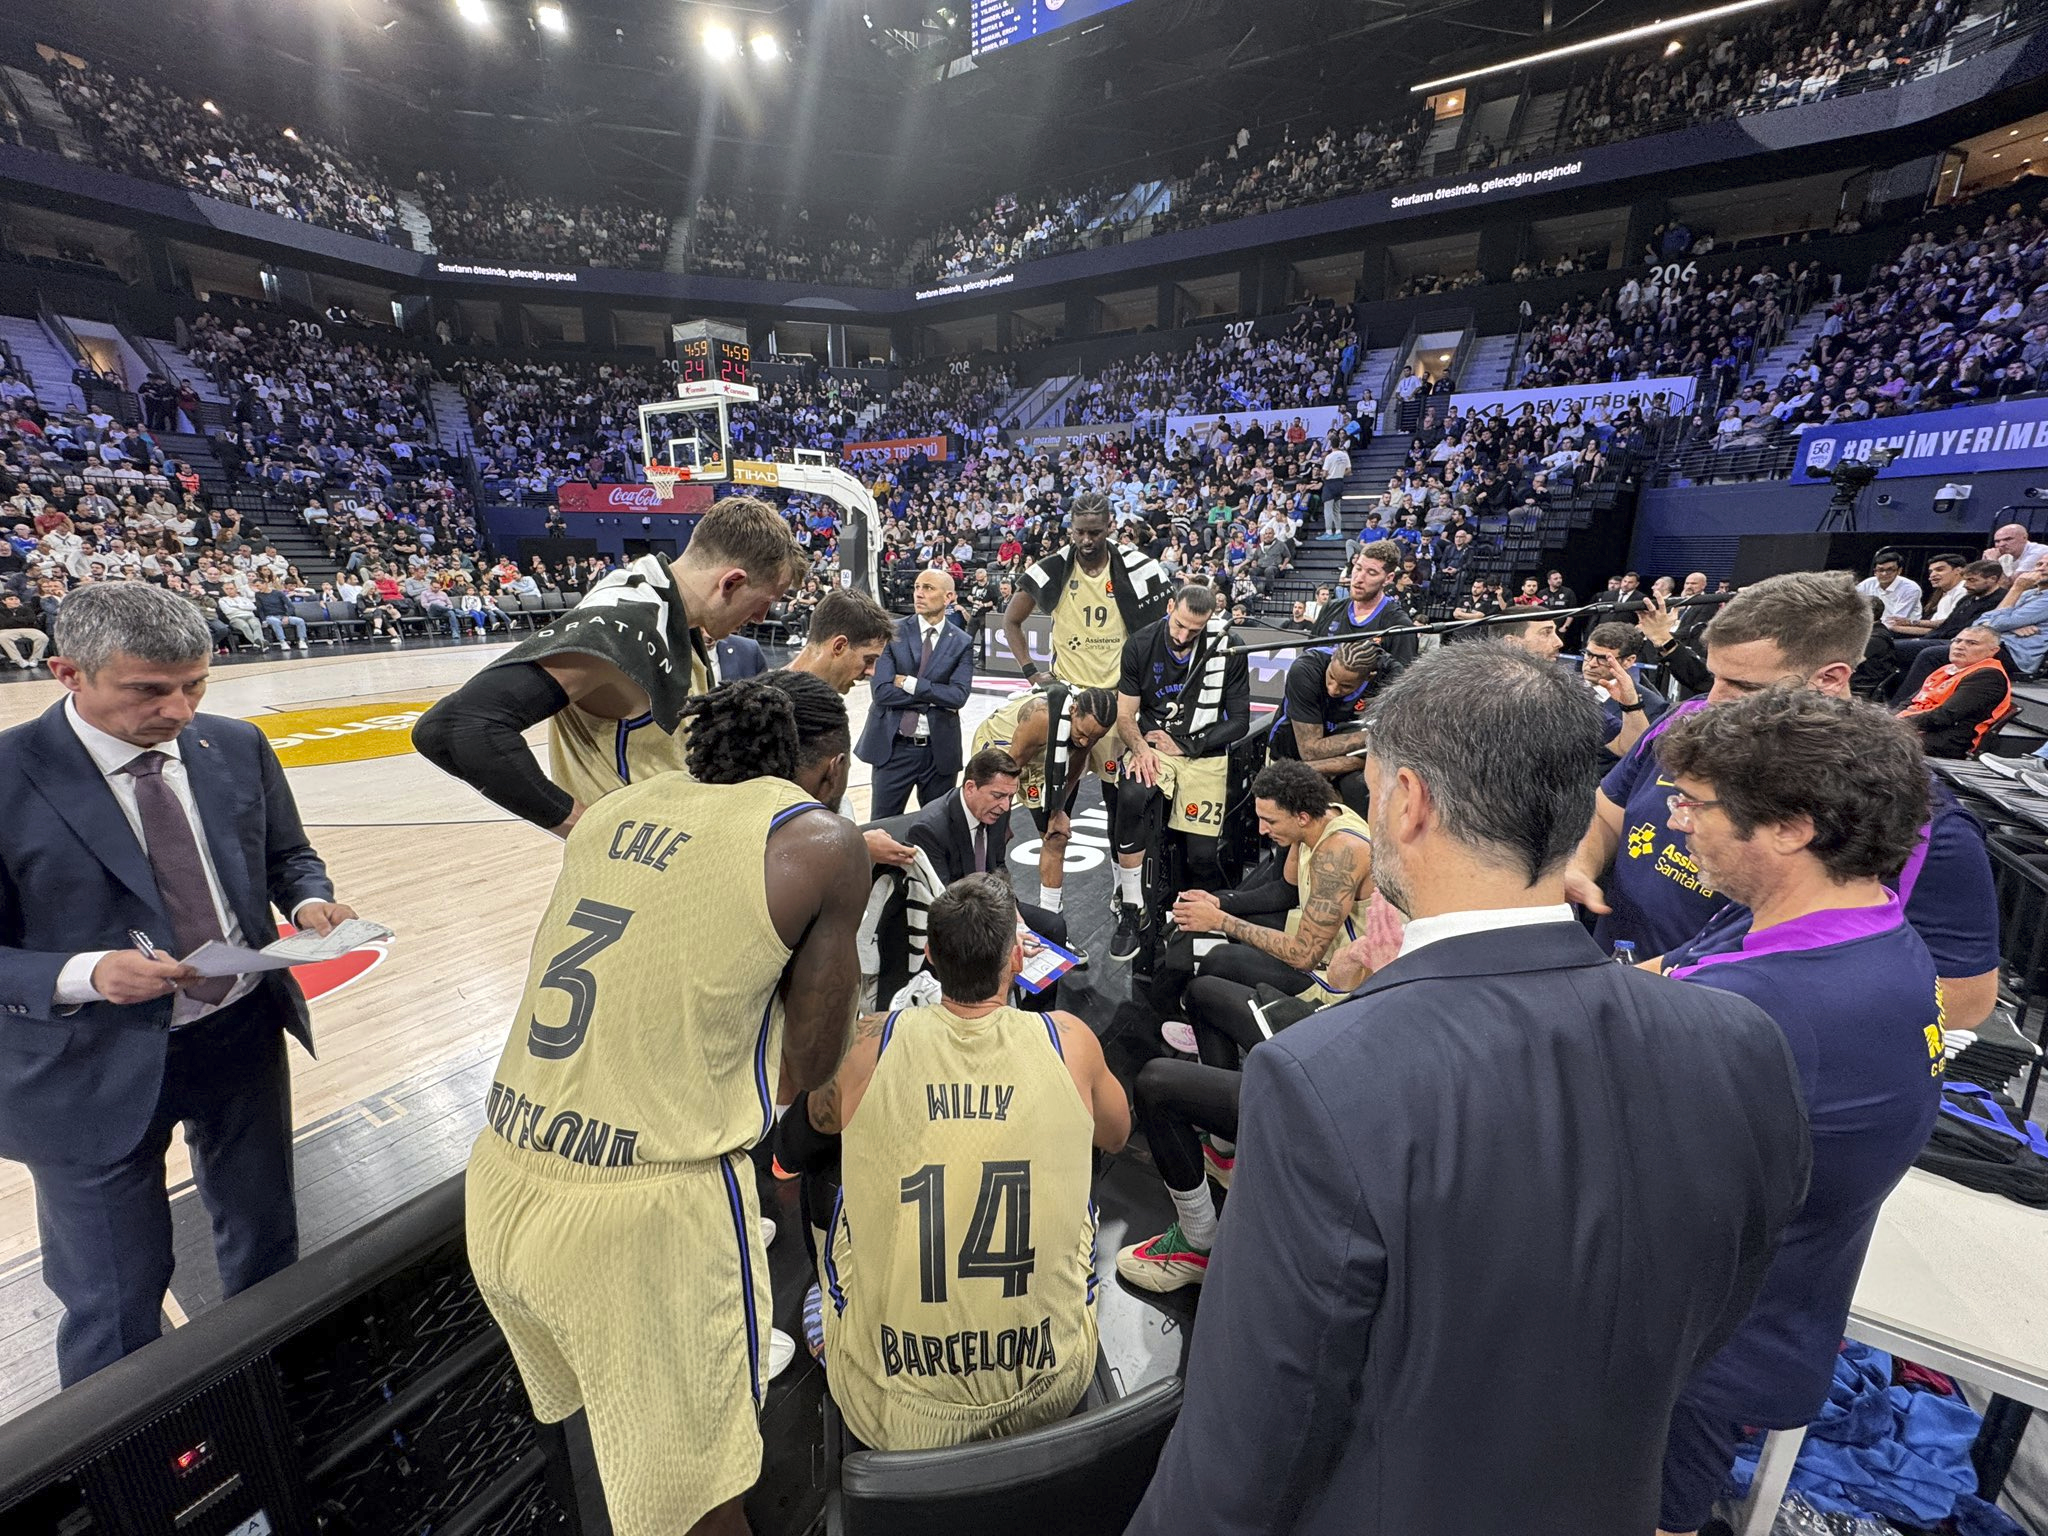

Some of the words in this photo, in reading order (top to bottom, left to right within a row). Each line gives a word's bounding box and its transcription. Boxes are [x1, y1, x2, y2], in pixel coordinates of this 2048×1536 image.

[1649, 261, 1698, 285] 206
[684, 340, 707, 357] 4:59
[722, 343, 749, 362] 4:59
[684, 359, 705, 382] 24
[721, 360, 745, 383] 24
[1083, 605, 1108, 628] 19
[1199, 800, 1223, 826] 23
[608, 820, 693, 873] CALE
[527, 897, 636, 1060] 3
[926, 1083, 1014, 1121] WILLY
[900, 1159, 1036, 1304] 14
[880, 1316, 1057, 1378] BARCELONA
